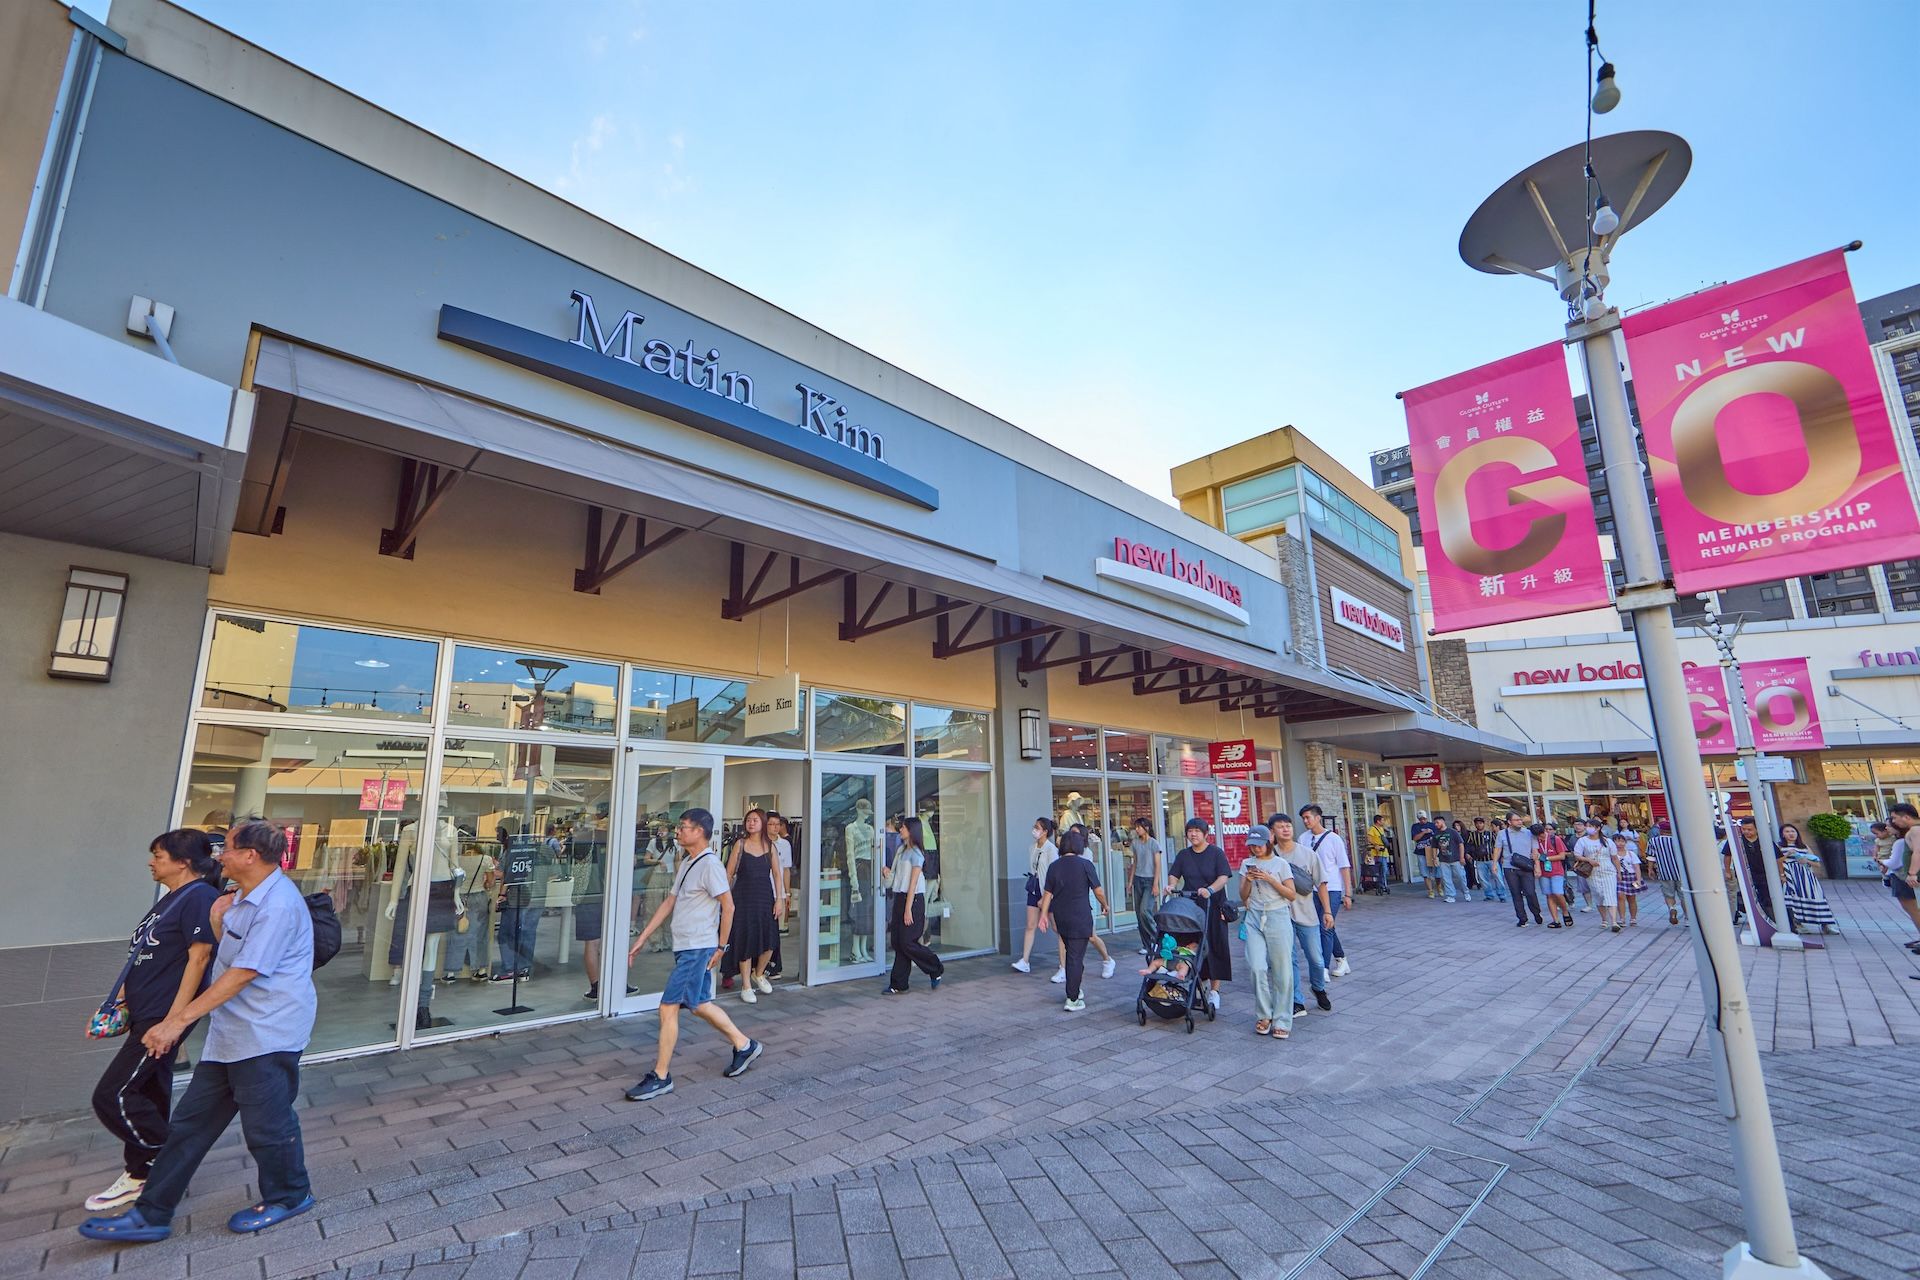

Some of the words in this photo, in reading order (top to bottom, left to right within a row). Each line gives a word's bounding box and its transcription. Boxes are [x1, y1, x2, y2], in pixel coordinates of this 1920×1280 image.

[1699, 326, 1730, 339] GLORIA
[1731, 314, 1769, 328] OUTLETS
[1675, 327, 1806, 381] NEW
[569, 289, 759, 411] Matin
[796, 382, 888, 465] Kim
[1435, 407, 1545, 449] 會員權益
[1671, 360, 1862, 525] O
[1434, 435, 1567, 576] G
[1698, 502, 1872, 545] MEMBERSHIP
[1701, 537, 1773, 559] REWARD
[1781, 518, 1878, 543] PROGRAM
[1114, 537, 1167, 575] new
[1171, 547, 1243, 608] balance
[1479, 567, 1574, 598] 新升級
[1341, 600, 1363, 625] new
[1363, 606, 1402, 643] balance
[1513, 668, 1571, 687] new
[1756, 678, 1795, 687] NEW
[748, 703, 770, 715] Matin
[776, 698, 792, 710] Kim
[1755, 685, 1810, 733] O
[1227, 761, 1252, 769] balance
